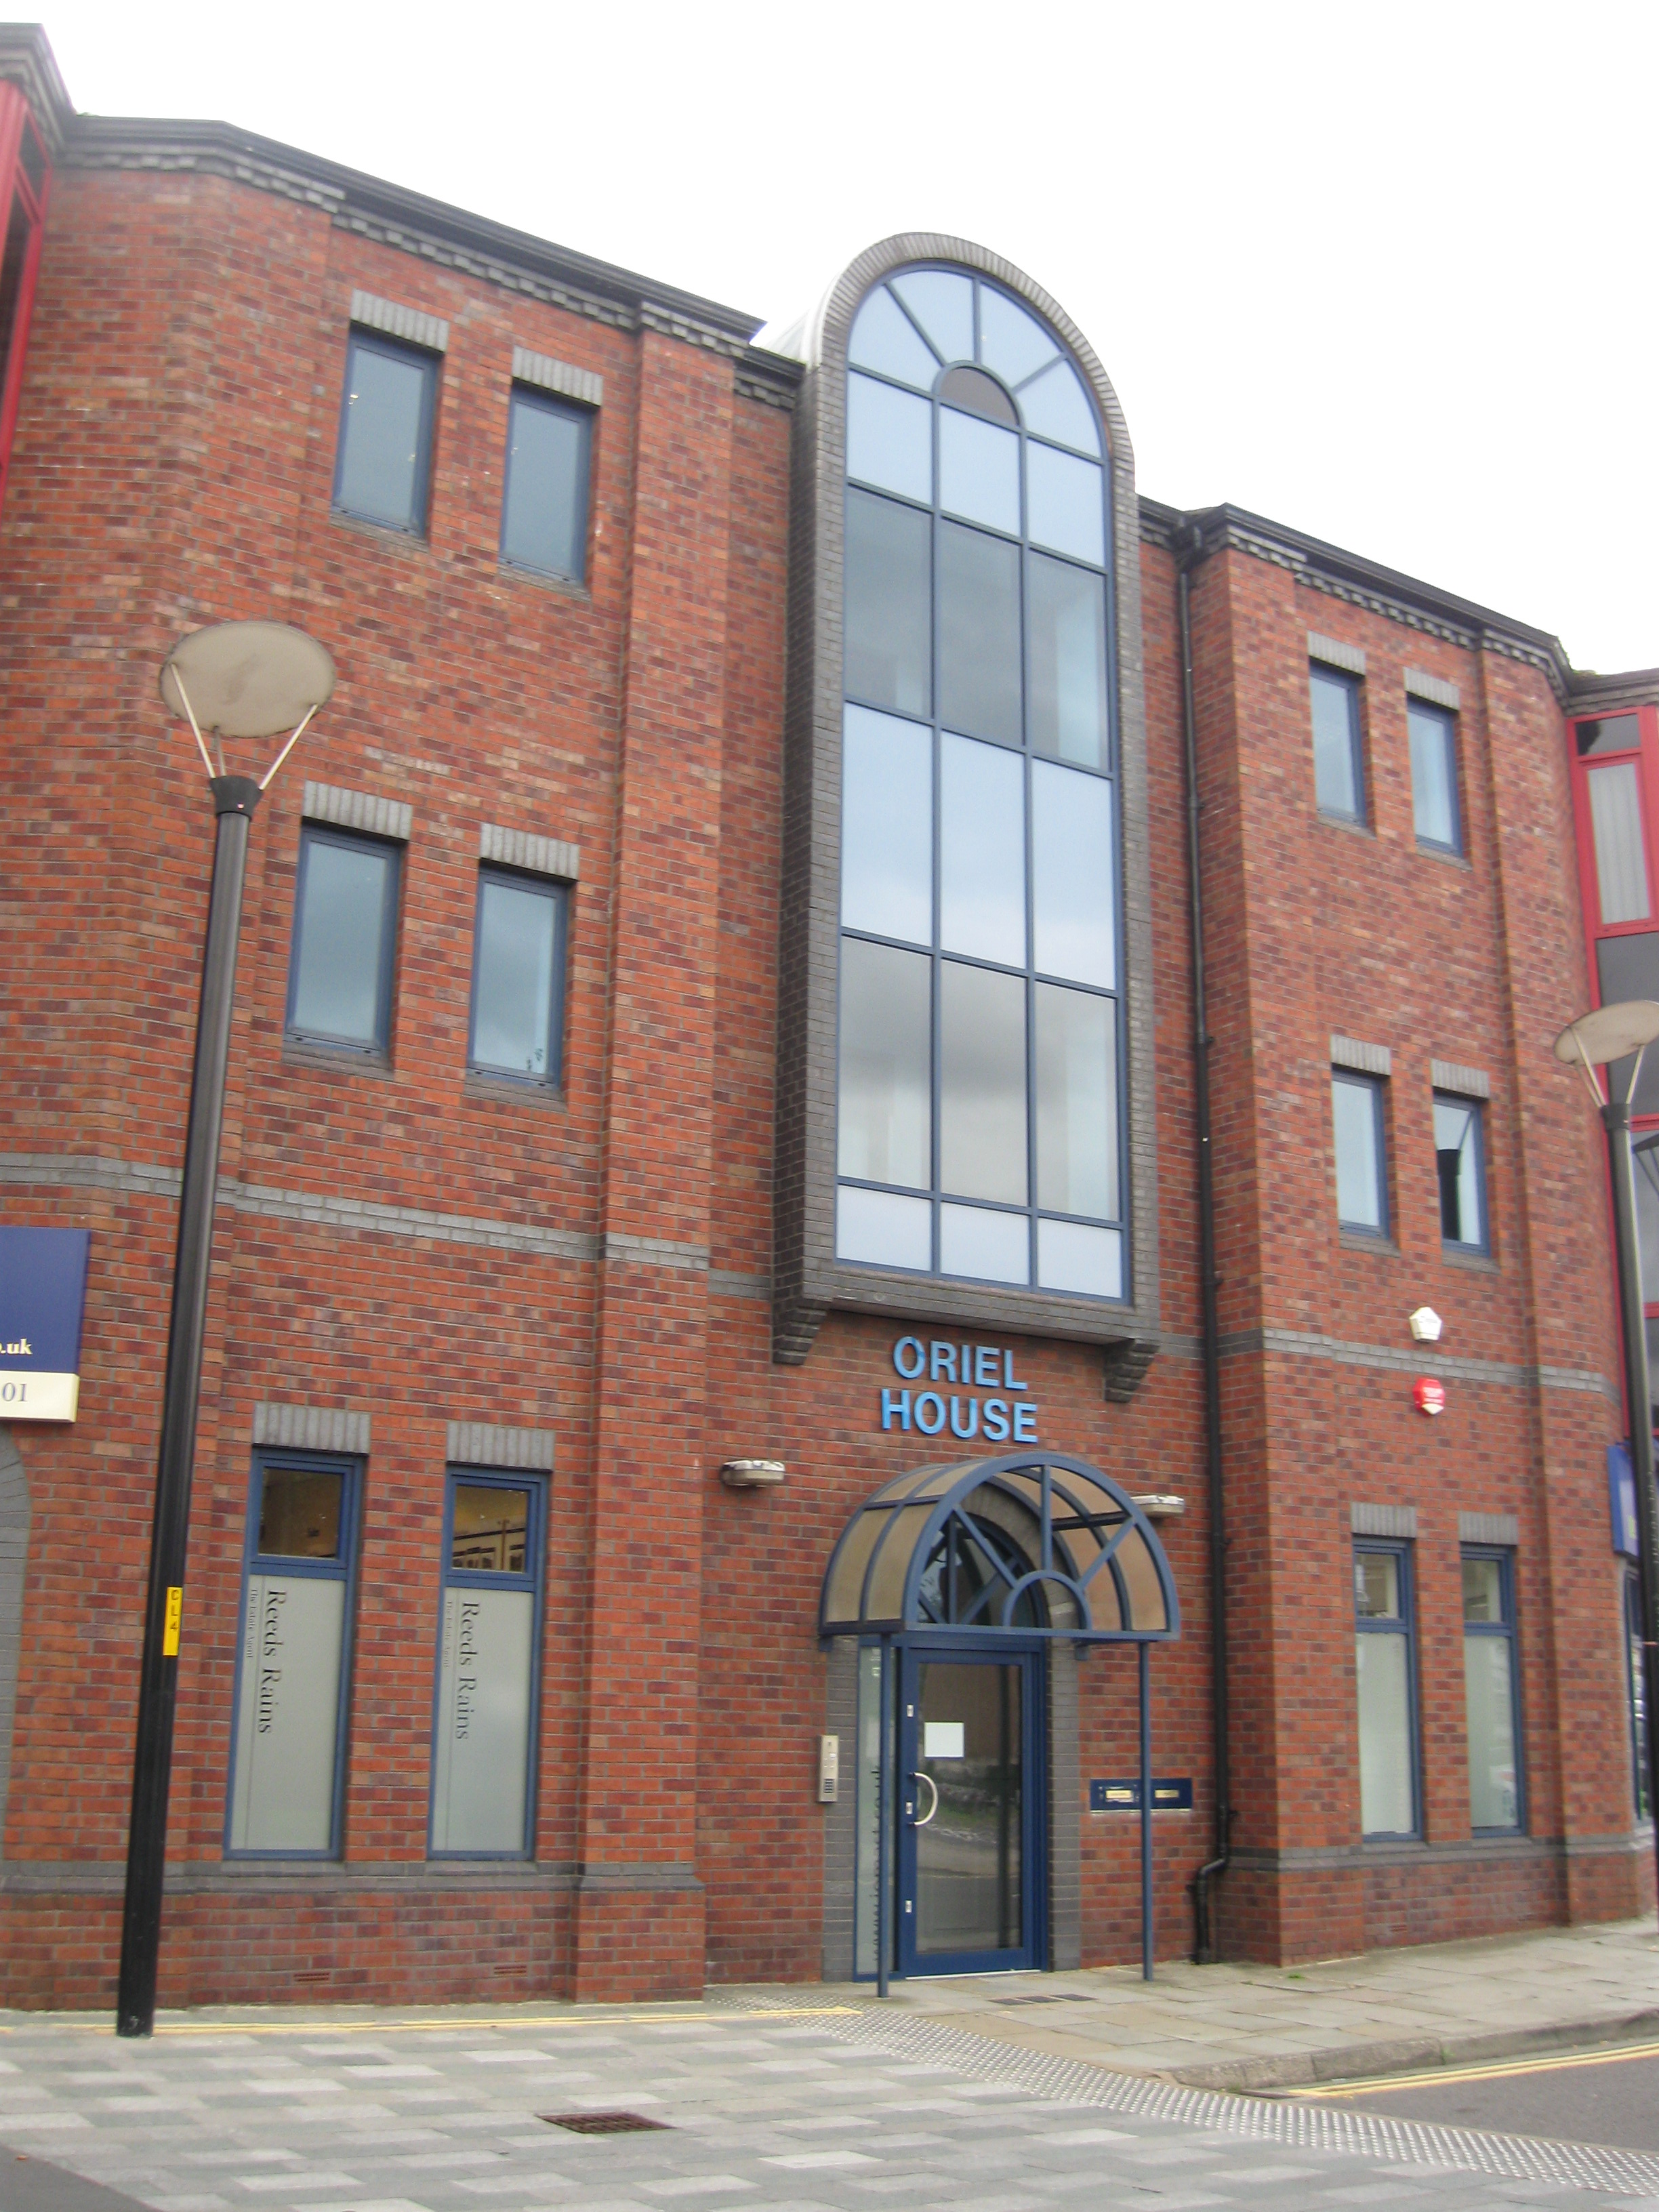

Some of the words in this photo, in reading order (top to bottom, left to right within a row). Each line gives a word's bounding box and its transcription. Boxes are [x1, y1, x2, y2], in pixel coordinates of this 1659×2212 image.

[0, 1337, 33, 1355] .uk
[893, 1336, 1028, 1390] ORIEL
[881, 1388, 1038, 1443] HOUSE
[264, 1590, 287, 1656] Reeds
[460, 1602, 480, 1666] Reeds
[258, 1668, 282, 1734] Rains
[456, 1677, 476, 1740] Rains
